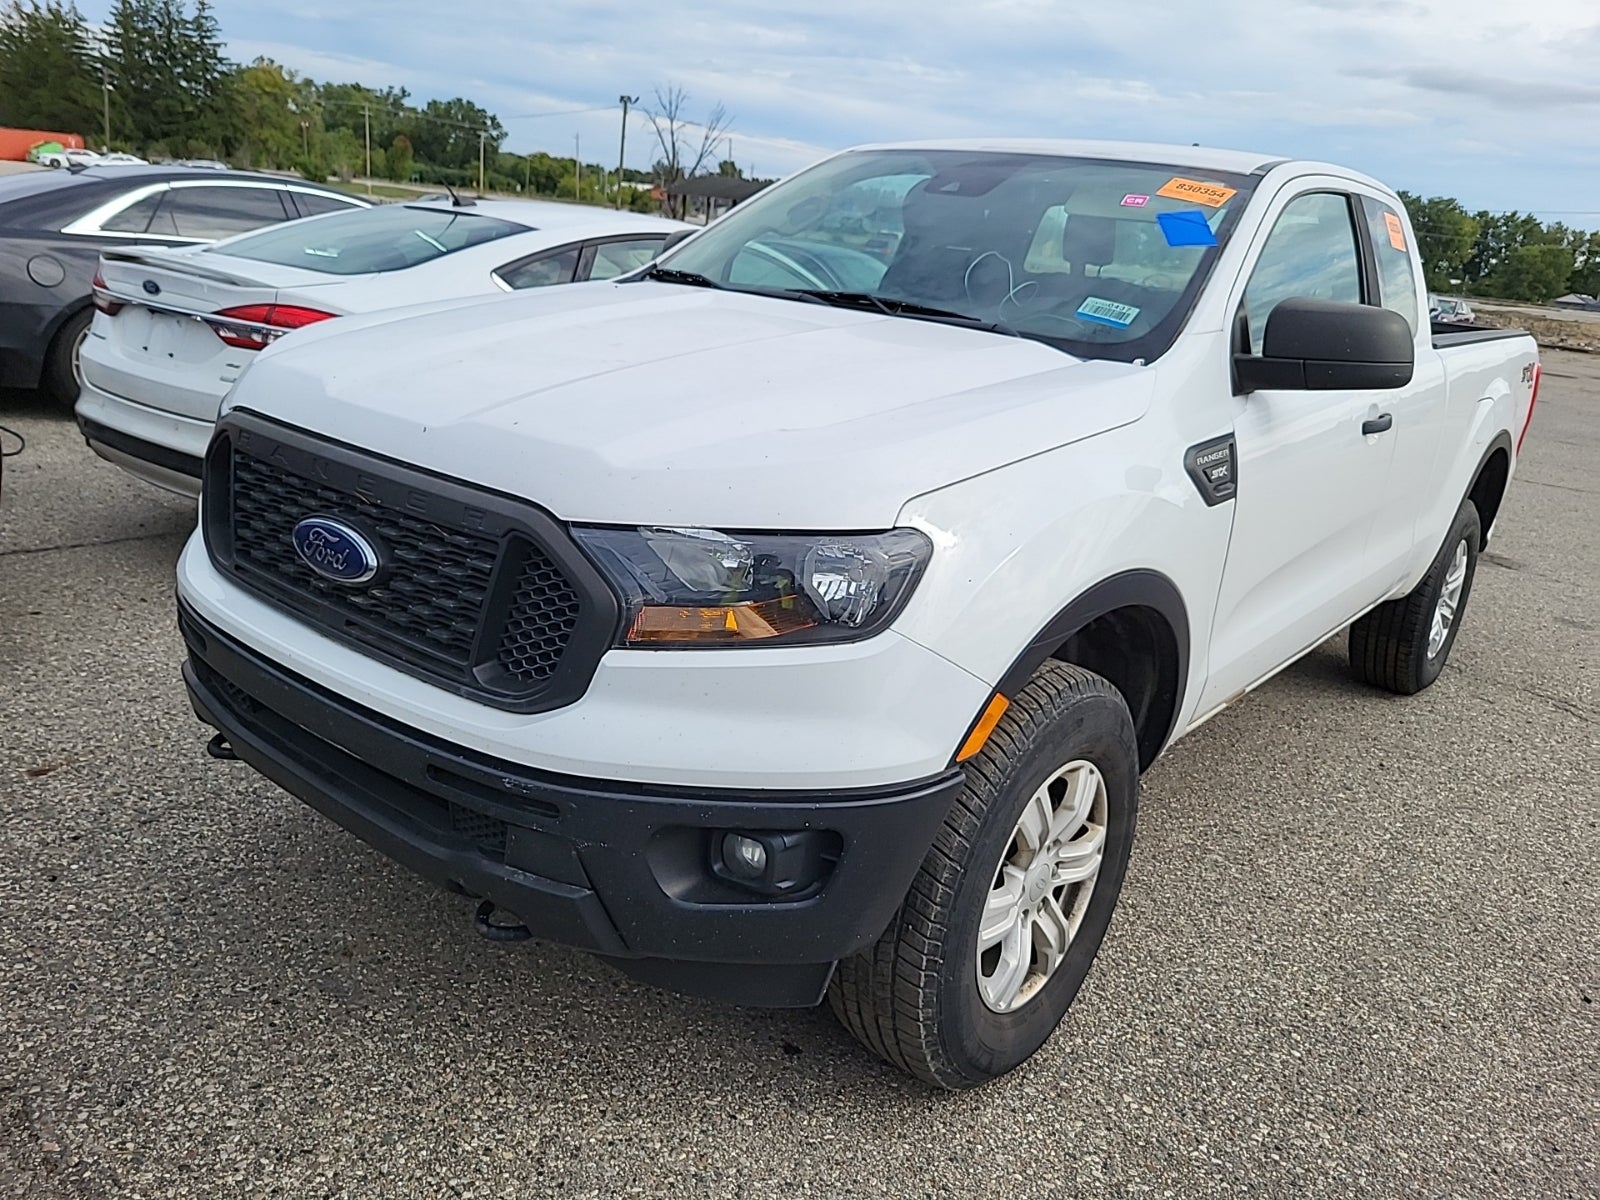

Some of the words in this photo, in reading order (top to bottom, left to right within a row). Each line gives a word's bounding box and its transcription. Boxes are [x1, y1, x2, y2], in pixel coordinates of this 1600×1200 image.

[1175, 183, 1227, 198] 830354
[1196, 449, 1229, 465] RANGER
[303, 527, 350, 570] Ford
